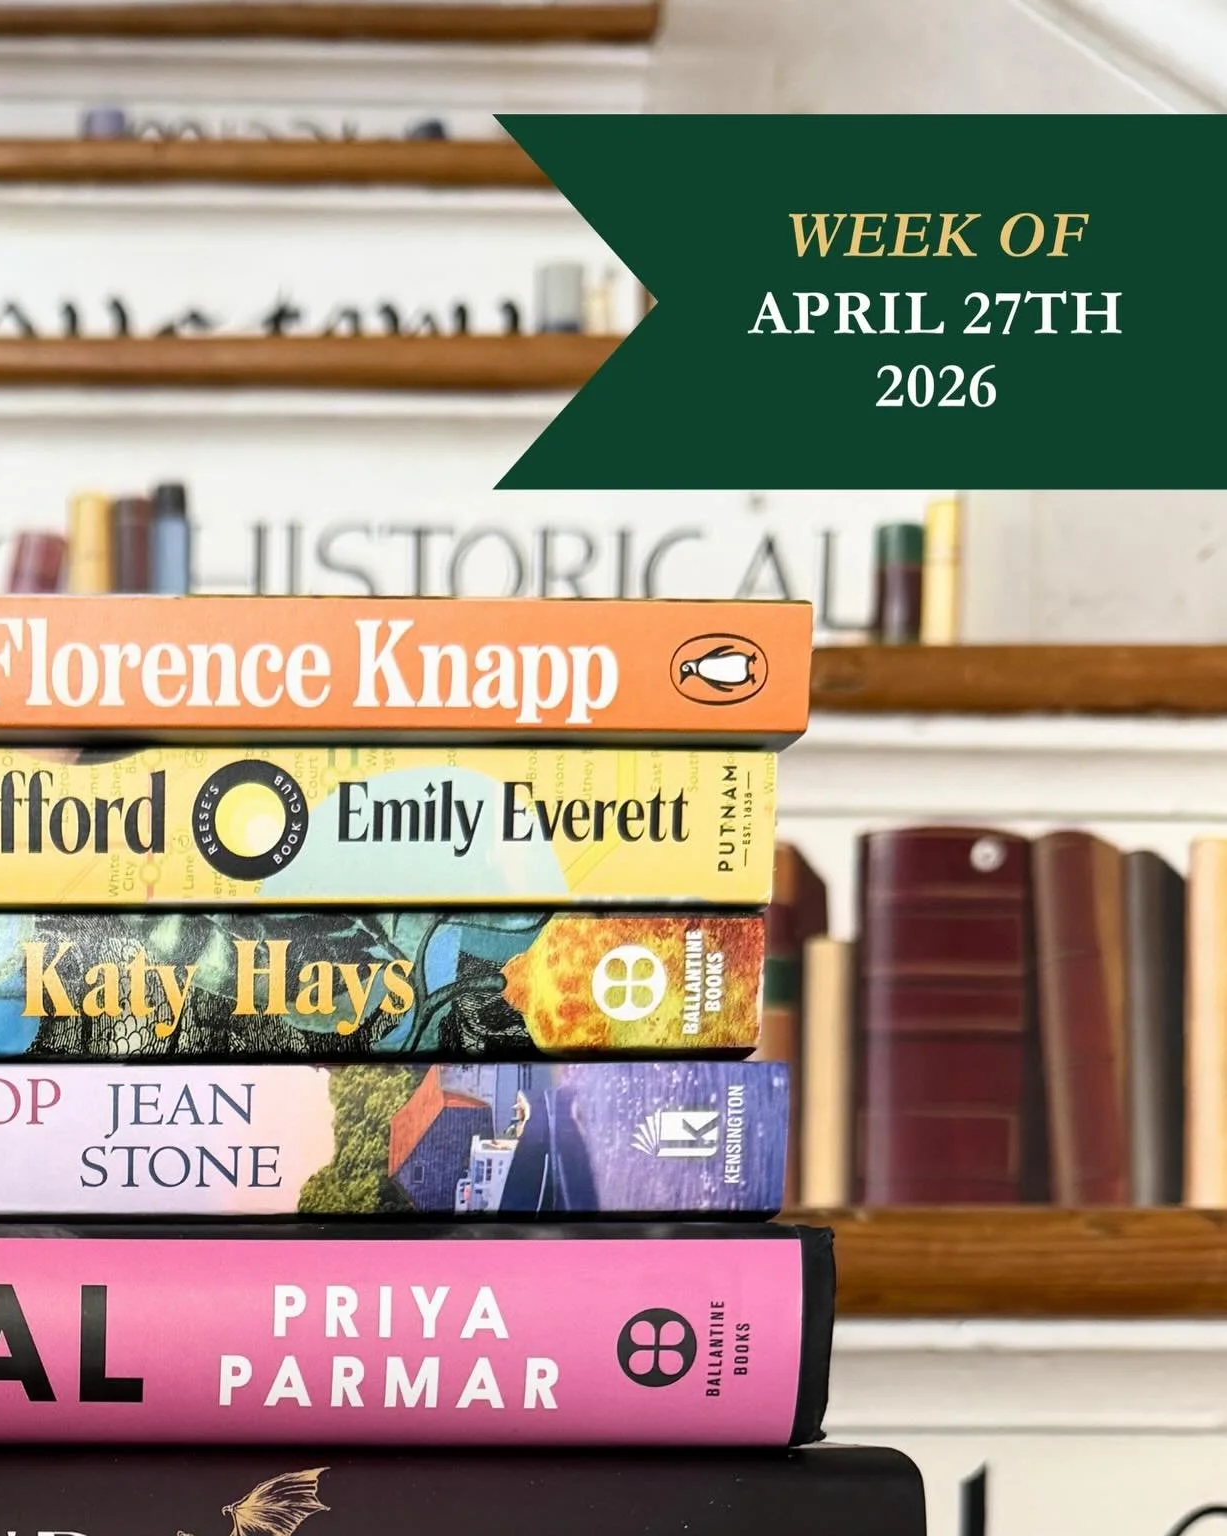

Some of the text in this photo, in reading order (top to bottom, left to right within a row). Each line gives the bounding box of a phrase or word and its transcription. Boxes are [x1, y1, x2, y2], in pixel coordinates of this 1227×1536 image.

[352, 618, 619, 724] Knapp
[305, 756, 318, 800] Court
[198, 782, 221, 857] REESE'S
[272, 774, 302, 865] BOOK CLUB
[337, 779, 485, 857] Emily
[502, 781, 690, 843] Everett
[717, 765, 738, 872] PUTNAM
[742, 822, 752, 846] EST.
[108, 854, 121, 898] White
[122, 861, 137, 893] City
[182, 855, 195, 891] Lane
[20, 938, 416, 1038] Katy Hays
[682, 931, 703, 1035] BALLANTINE
[704, 952, 723, 1012] BOOKS
[105, 1082, 254, 1140] JEAN
[723, 1085, 744, 1184] KENSINGTON
[79, 1145, 283, 1189] STONE
[272, 1284, 510, 1340] PRIYA
[705, 1300, 724, 1397] BALLANTINE
[733, 1323, 750, 1375] BOOKS
[217, 1355, 560, 1411] PARMAR
